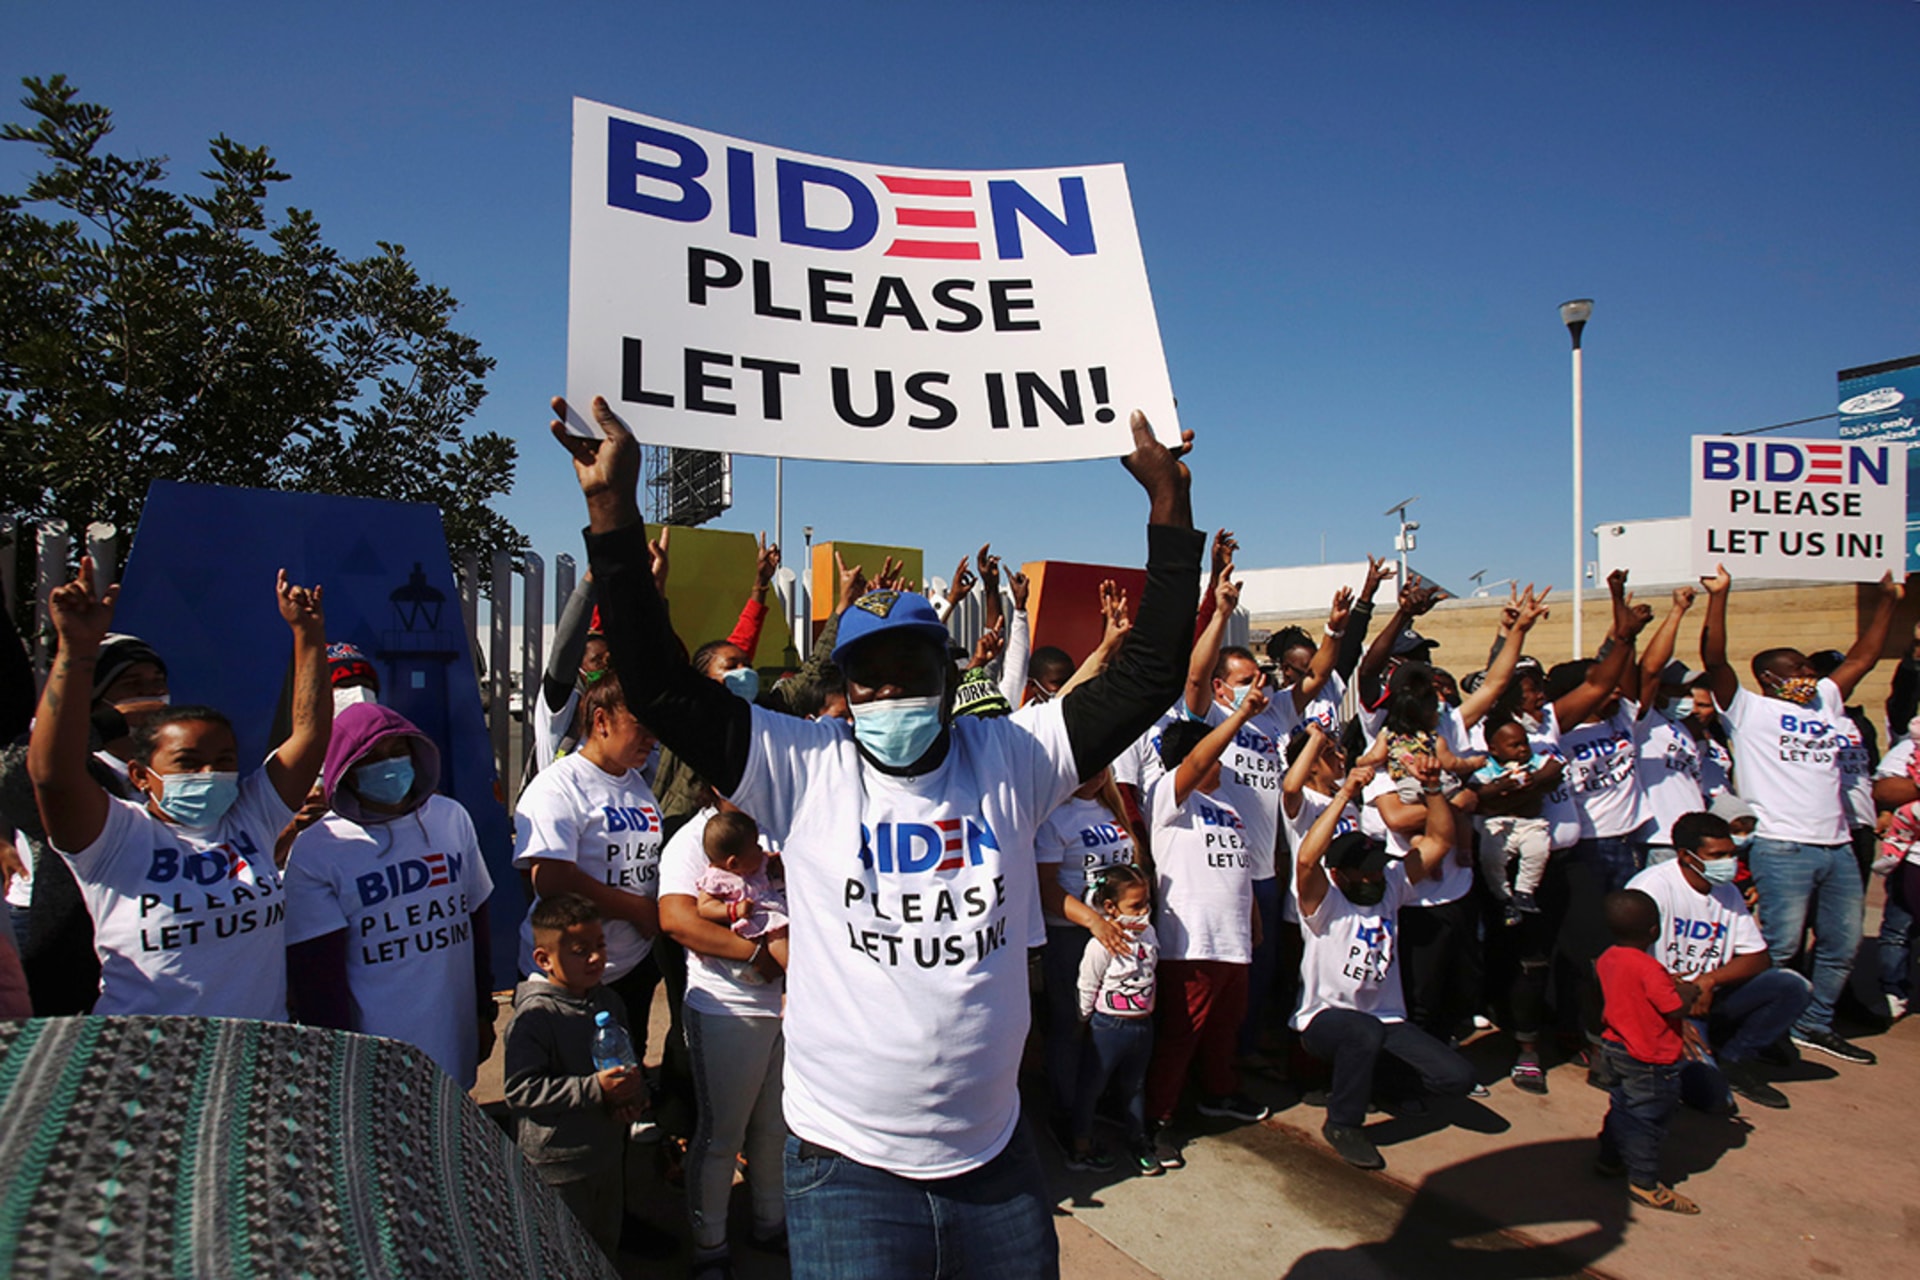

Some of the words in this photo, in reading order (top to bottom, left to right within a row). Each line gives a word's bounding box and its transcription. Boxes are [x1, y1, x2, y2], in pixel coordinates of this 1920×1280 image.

[607, 116, 1097, 260] BIDEN
[687, 246, 1041, 332] PLEASE
[622, 336, 800, 420] LET
[831, 367, 958, 430] US
[985, 366, 1117, 429] IN!
[1703, 440, 1889, 485] BIDEN
[1731, 489, 1861, 517] PLEASE
[1708, 529, 1769, 554] LET
[1780, 531, 1825, 556] US
[1837, 533, 1883, 559] IN!
[1780, 750, 1809, 762] LET
[1814, 751, 1832, 763] US
[1235, 772, 1258, 787] LET
[1261, 777, 1276, 790] US
[602, 806, 663, 833] BIDE
[356, 852, 462, 907] BIDEN
[1208, 853, 1234, 868] LET
[361, 893, 468, 937] PLEASE
[845, 874, 1006, 923] PLEASE
[141, 921, 205, 951] LET
[215, 910, 257, 938] US
[362, 937, 409, 965] LET
[415, 927, 449, 952] US
[847, 922, 903, 966] LET
[914, 935, 966, 969] US
